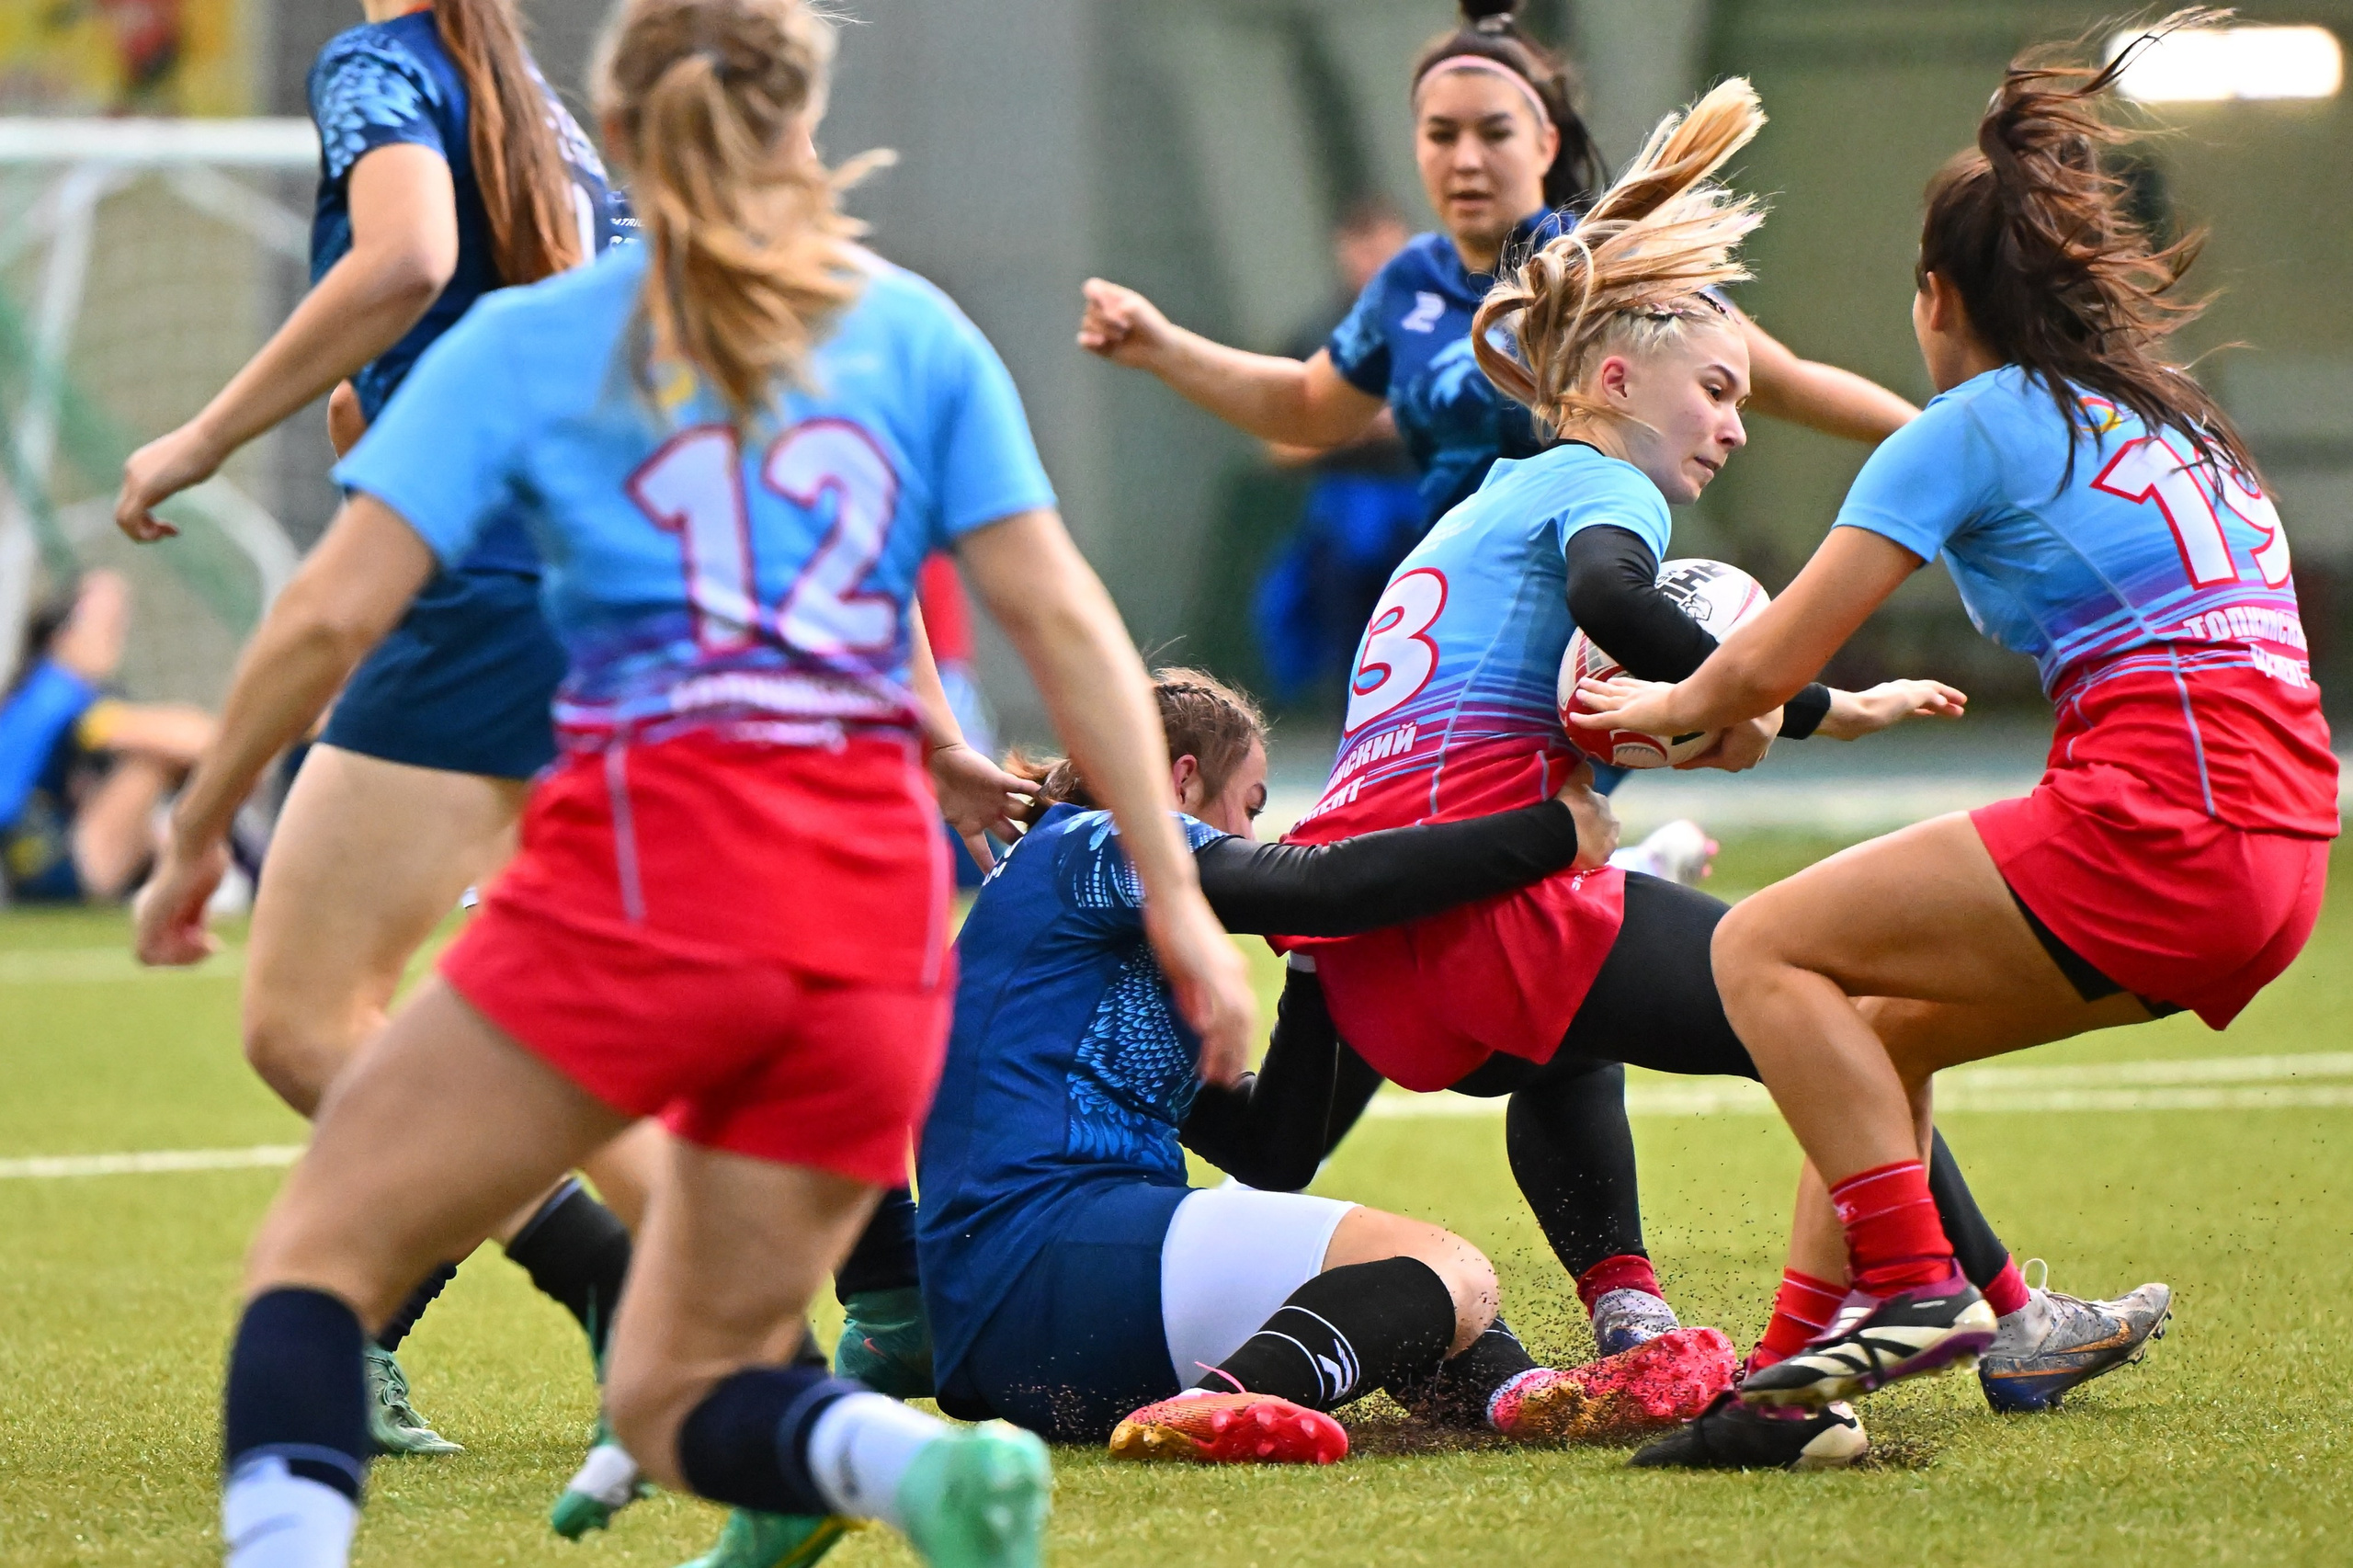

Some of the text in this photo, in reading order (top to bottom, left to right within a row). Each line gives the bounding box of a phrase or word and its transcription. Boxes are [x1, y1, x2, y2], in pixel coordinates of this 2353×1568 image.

[1402, 290, 1446, 333] 2
[625, 415, 901, 654] 12
[2089, 436, 2291, 590] 19
[1344, 567, 1449, 739] 3
